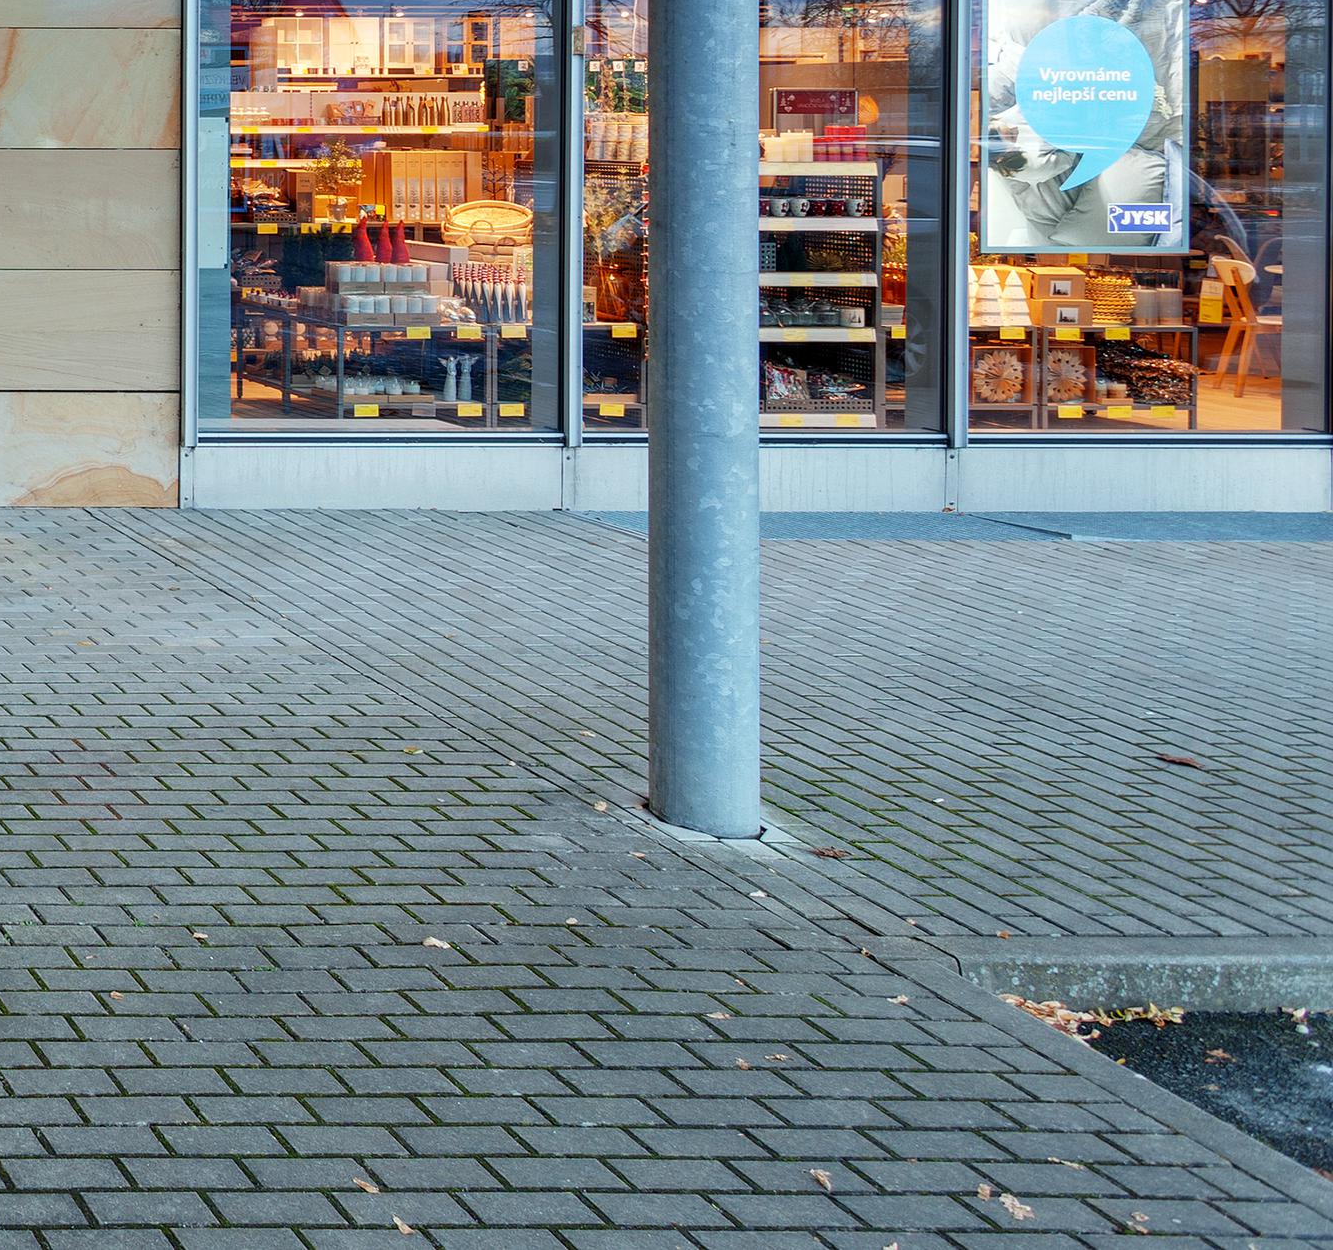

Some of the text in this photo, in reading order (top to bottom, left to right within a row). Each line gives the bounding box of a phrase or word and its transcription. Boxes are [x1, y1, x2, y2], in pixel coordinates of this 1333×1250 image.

[1039, 67, 1132, 85] Vyrovnáme
[1032, 86, 1138, 104] nejlepší cenu
[1120, 210, 1169, 226] JYSK
